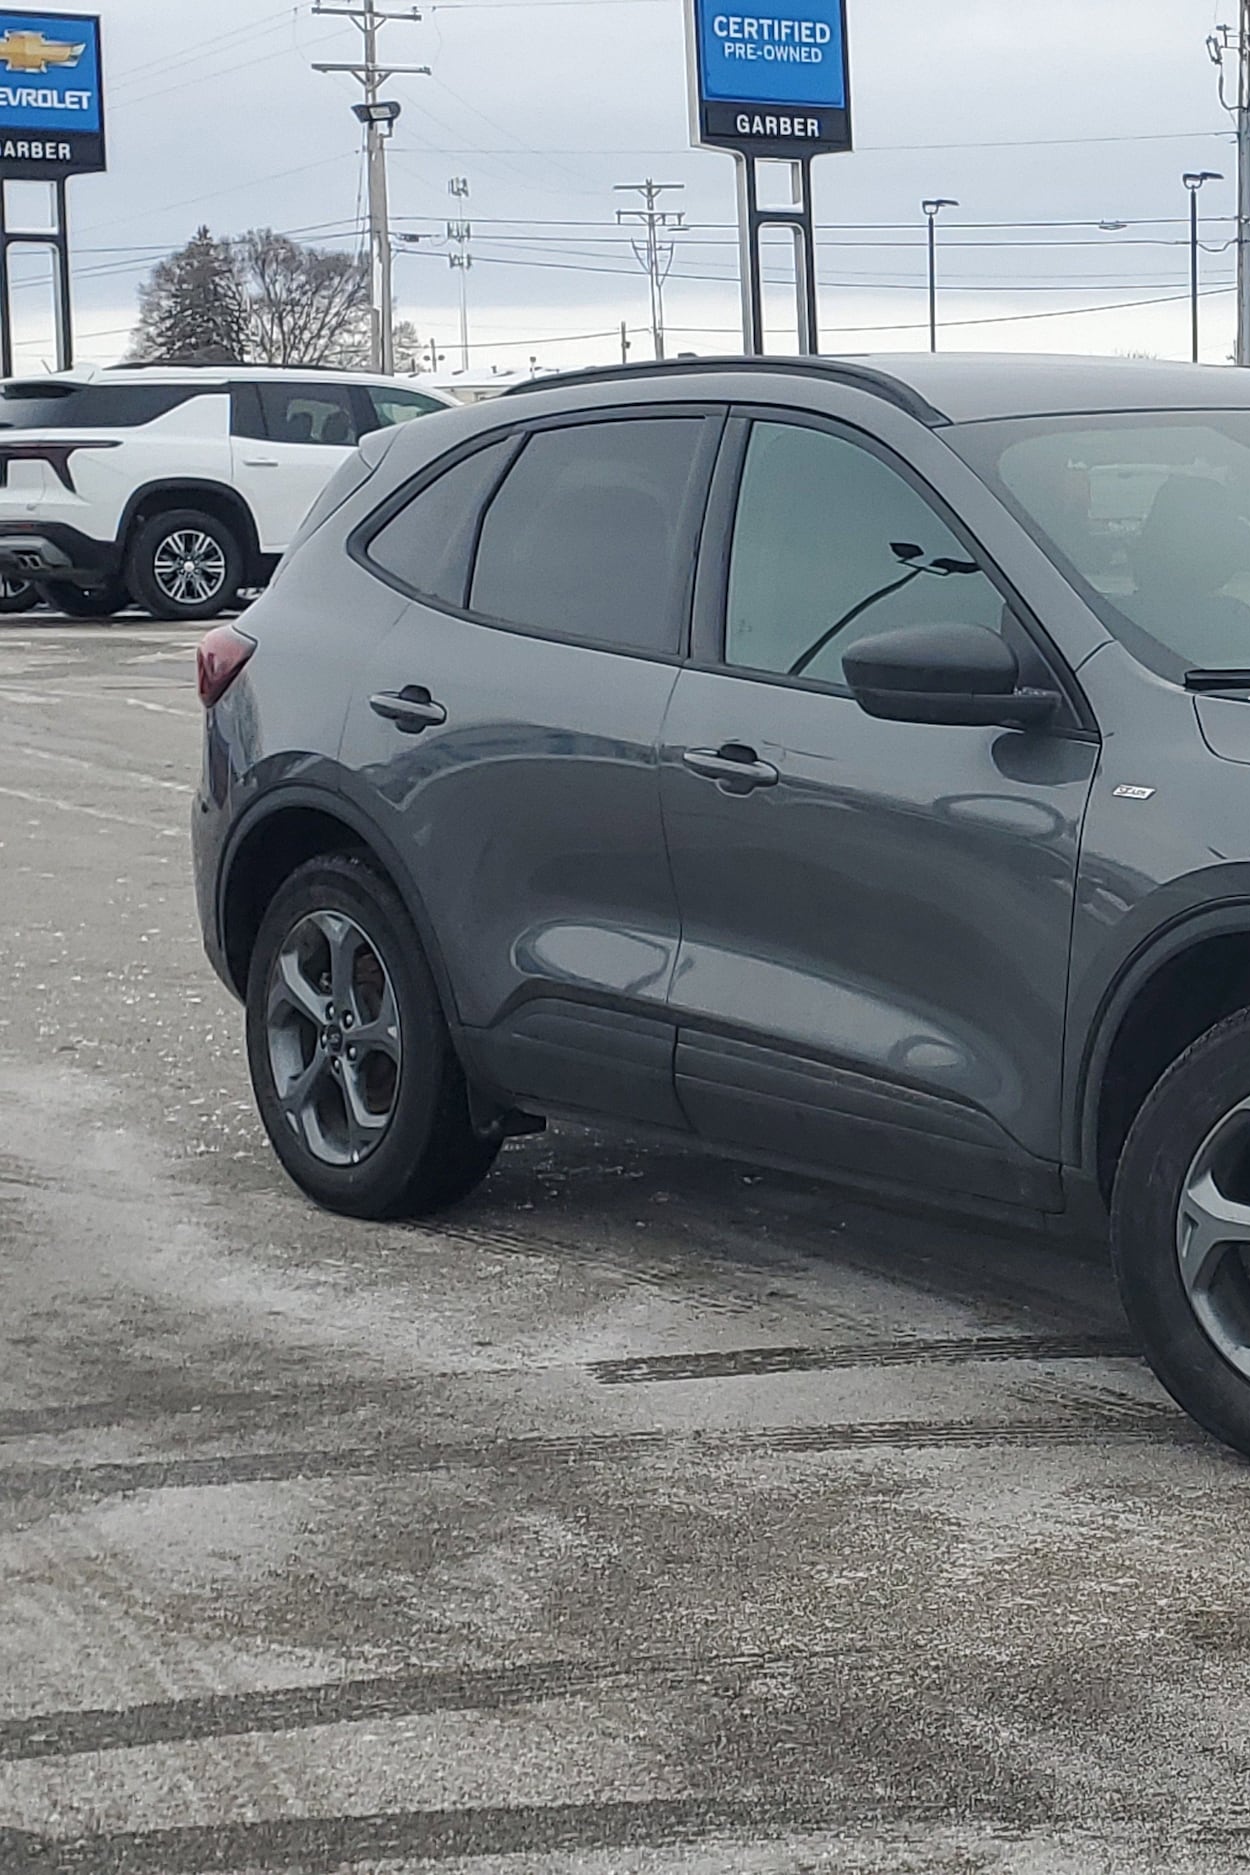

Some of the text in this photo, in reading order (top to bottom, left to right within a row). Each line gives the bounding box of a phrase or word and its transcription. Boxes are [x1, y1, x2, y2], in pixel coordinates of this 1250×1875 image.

[713, 15, 831, 44] CERTIFIED
[724, 42, 823, 63] PRE-OWNED
[736, 114, 820, 137] GARBER
[0, 140, 71, 160] ARBER
